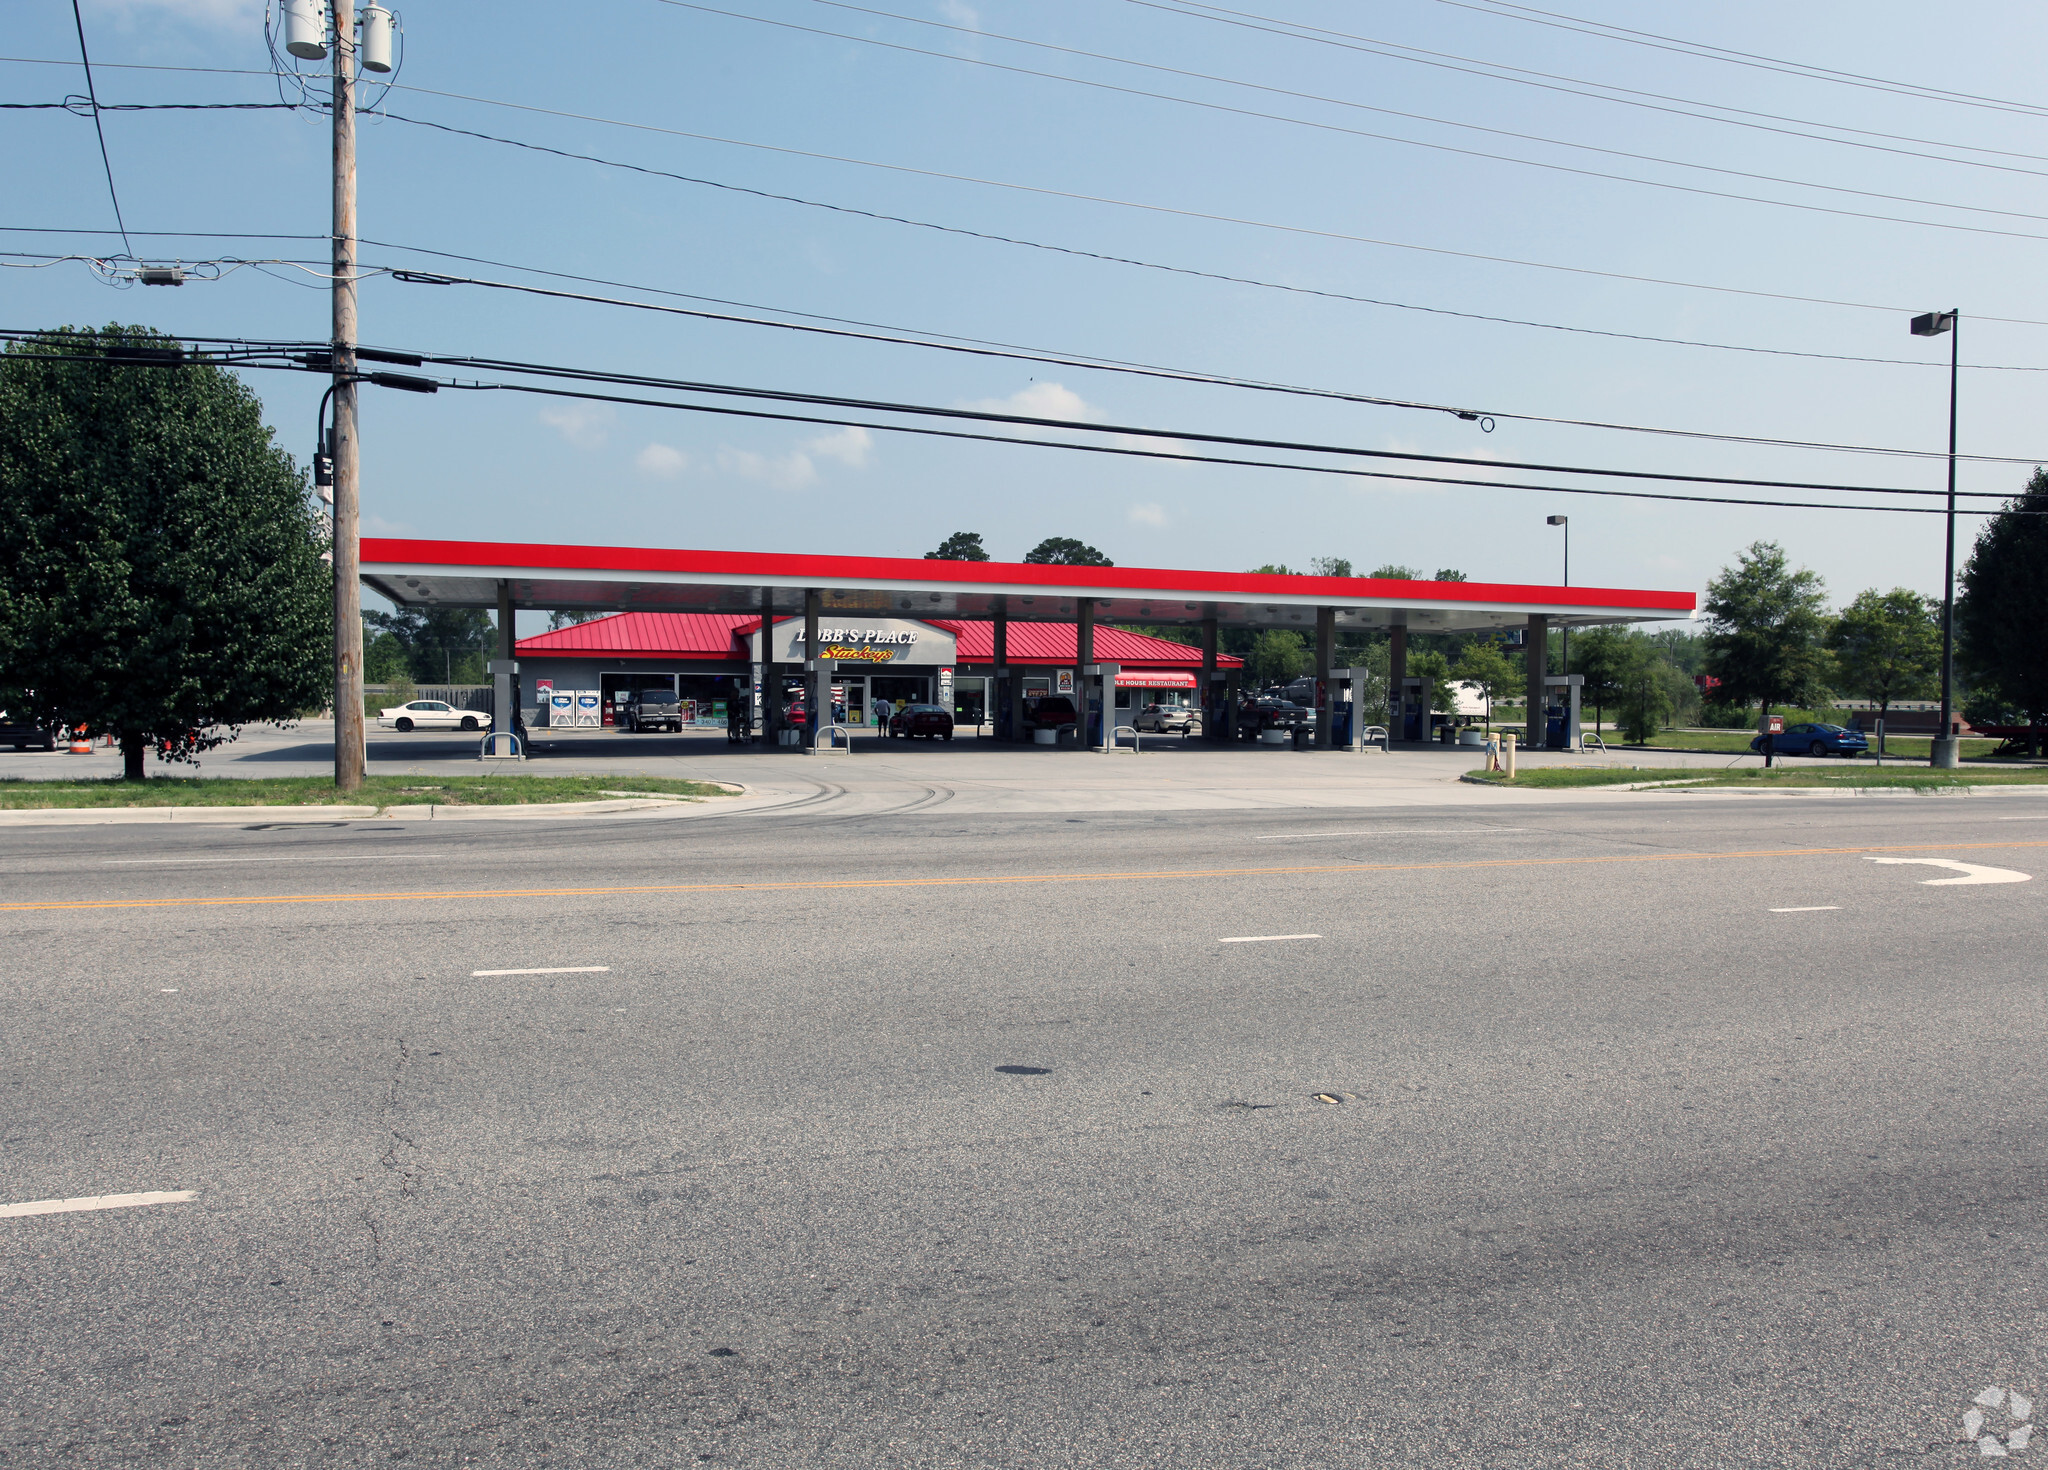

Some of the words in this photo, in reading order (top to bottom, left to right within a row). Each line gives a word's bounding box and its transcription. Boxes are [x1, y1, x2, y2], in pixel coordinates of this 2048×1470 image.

[862, 629, 919, 644] PLACE
[818, 643, 894, 663] Stuckey's
[1769, 723, 1781, 731] AIR
